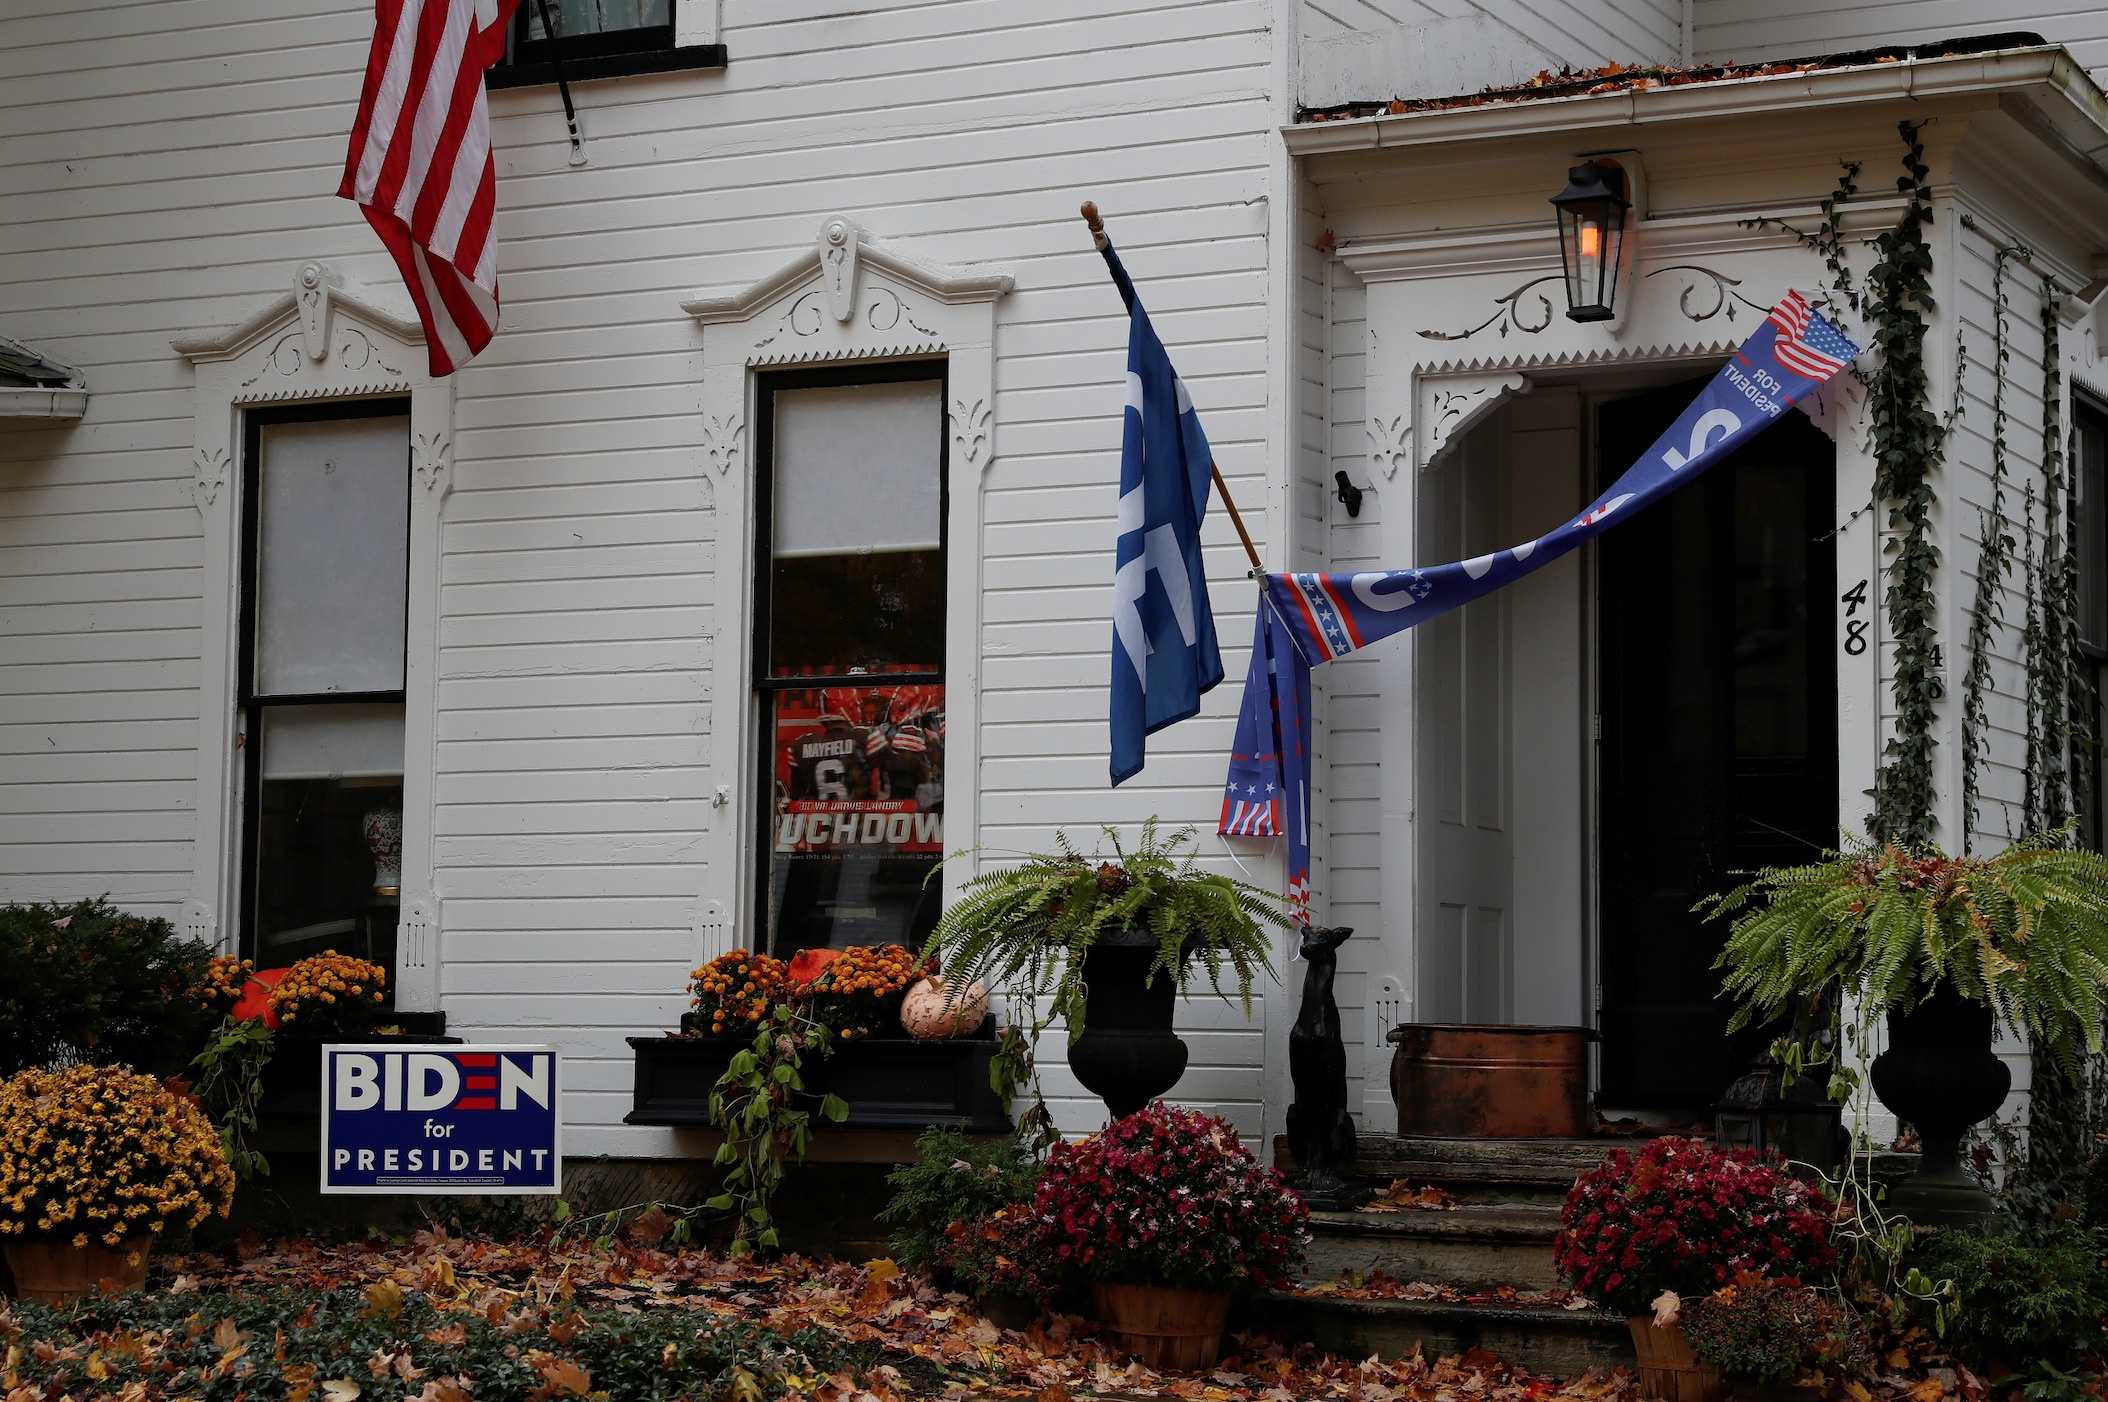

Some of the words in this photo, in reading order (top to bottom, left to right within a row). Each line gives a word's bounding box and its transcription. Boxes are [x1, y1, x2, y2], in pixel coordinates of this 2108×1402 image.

[1842, 579, 1869, 656] 48
[802, 738, 854, 759] MAYFIELD
[864, 802, 904, 810] LANDRY
[776, 812, 943, 845] UCHDOW
[335, 1053, 549, 1112] BIDEN
[424, 1118, 455, 1138] for
[334, 1149, 549, 1171] PRESIDENT
